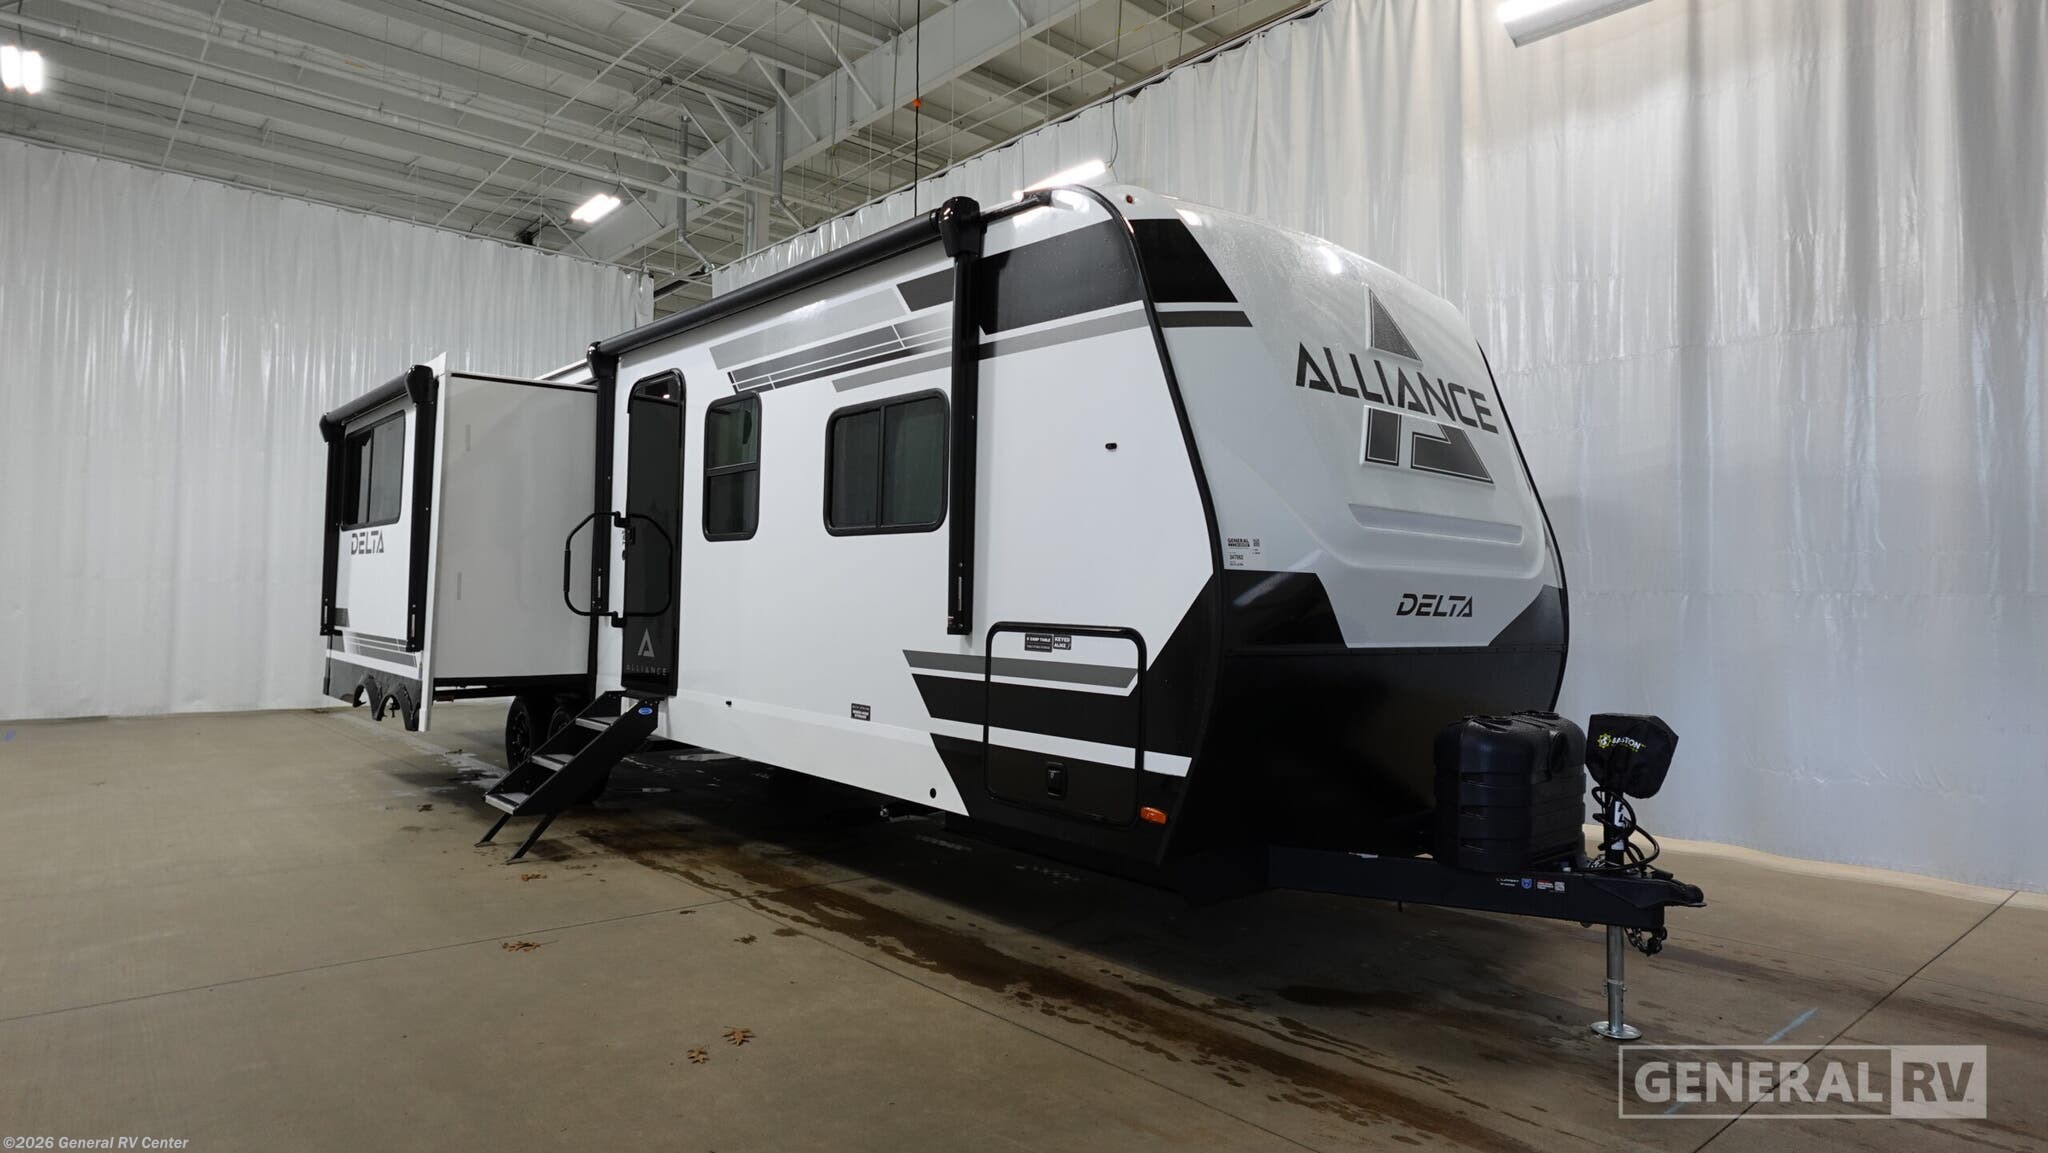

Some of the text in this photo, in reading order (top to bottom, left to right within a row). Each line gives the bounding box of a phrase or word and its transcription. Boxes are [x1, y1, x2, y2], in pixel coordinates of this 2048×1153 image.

[1296, 342, 1499, 434] ALLIANCE
[351, 530, 385, 555] DELTA
[1396, 593, 1473, 618] DELTA
[626, 664, 668, 676] ALLIANCE
